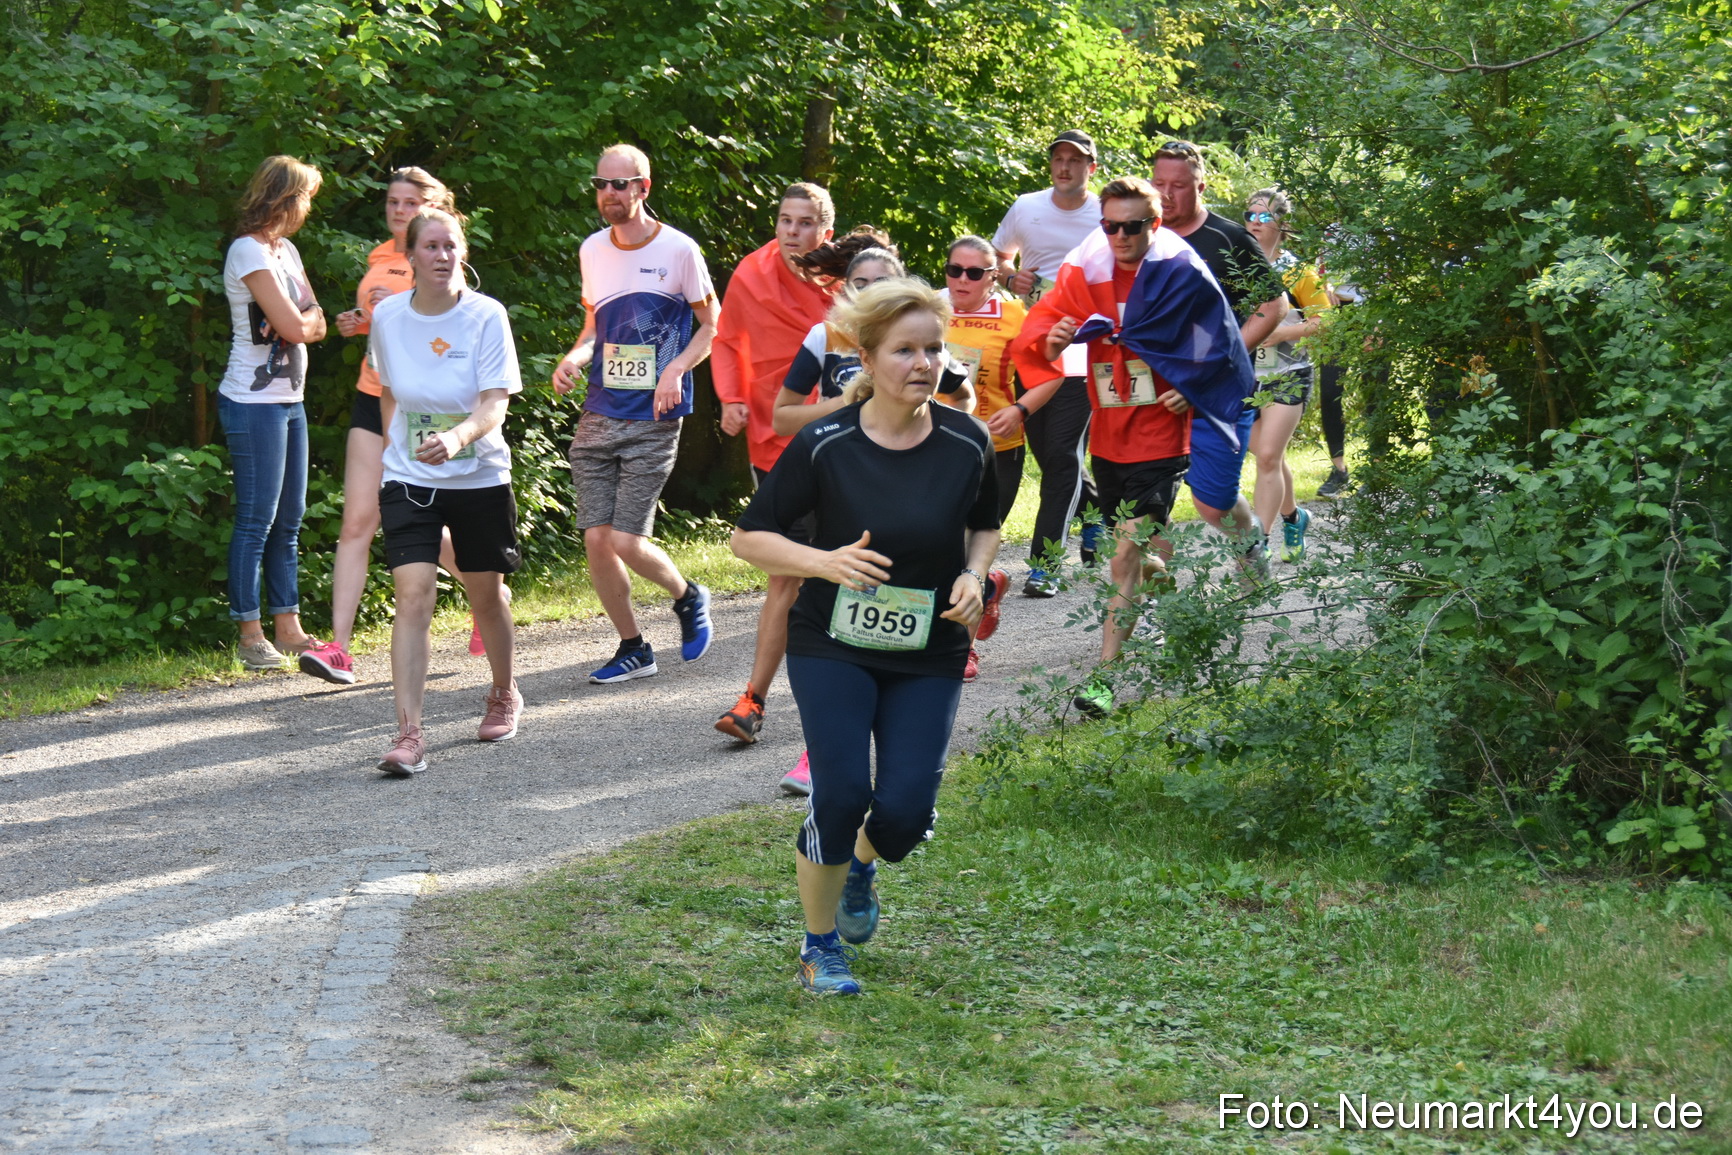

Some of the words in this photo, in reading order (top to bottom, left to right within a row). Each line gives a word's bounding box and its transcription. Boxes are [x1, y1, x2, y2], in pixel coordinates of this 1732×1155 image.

[964, 320, 1002, 332] BÖGL
[608, 360, 647, 377] 2128
[1108, 376, 1138, 395] 47
[847, 601, 917, 637] 1959
[852, 626, 874, 638] Faltus
[876, 632, 904, 643] Gudrun
